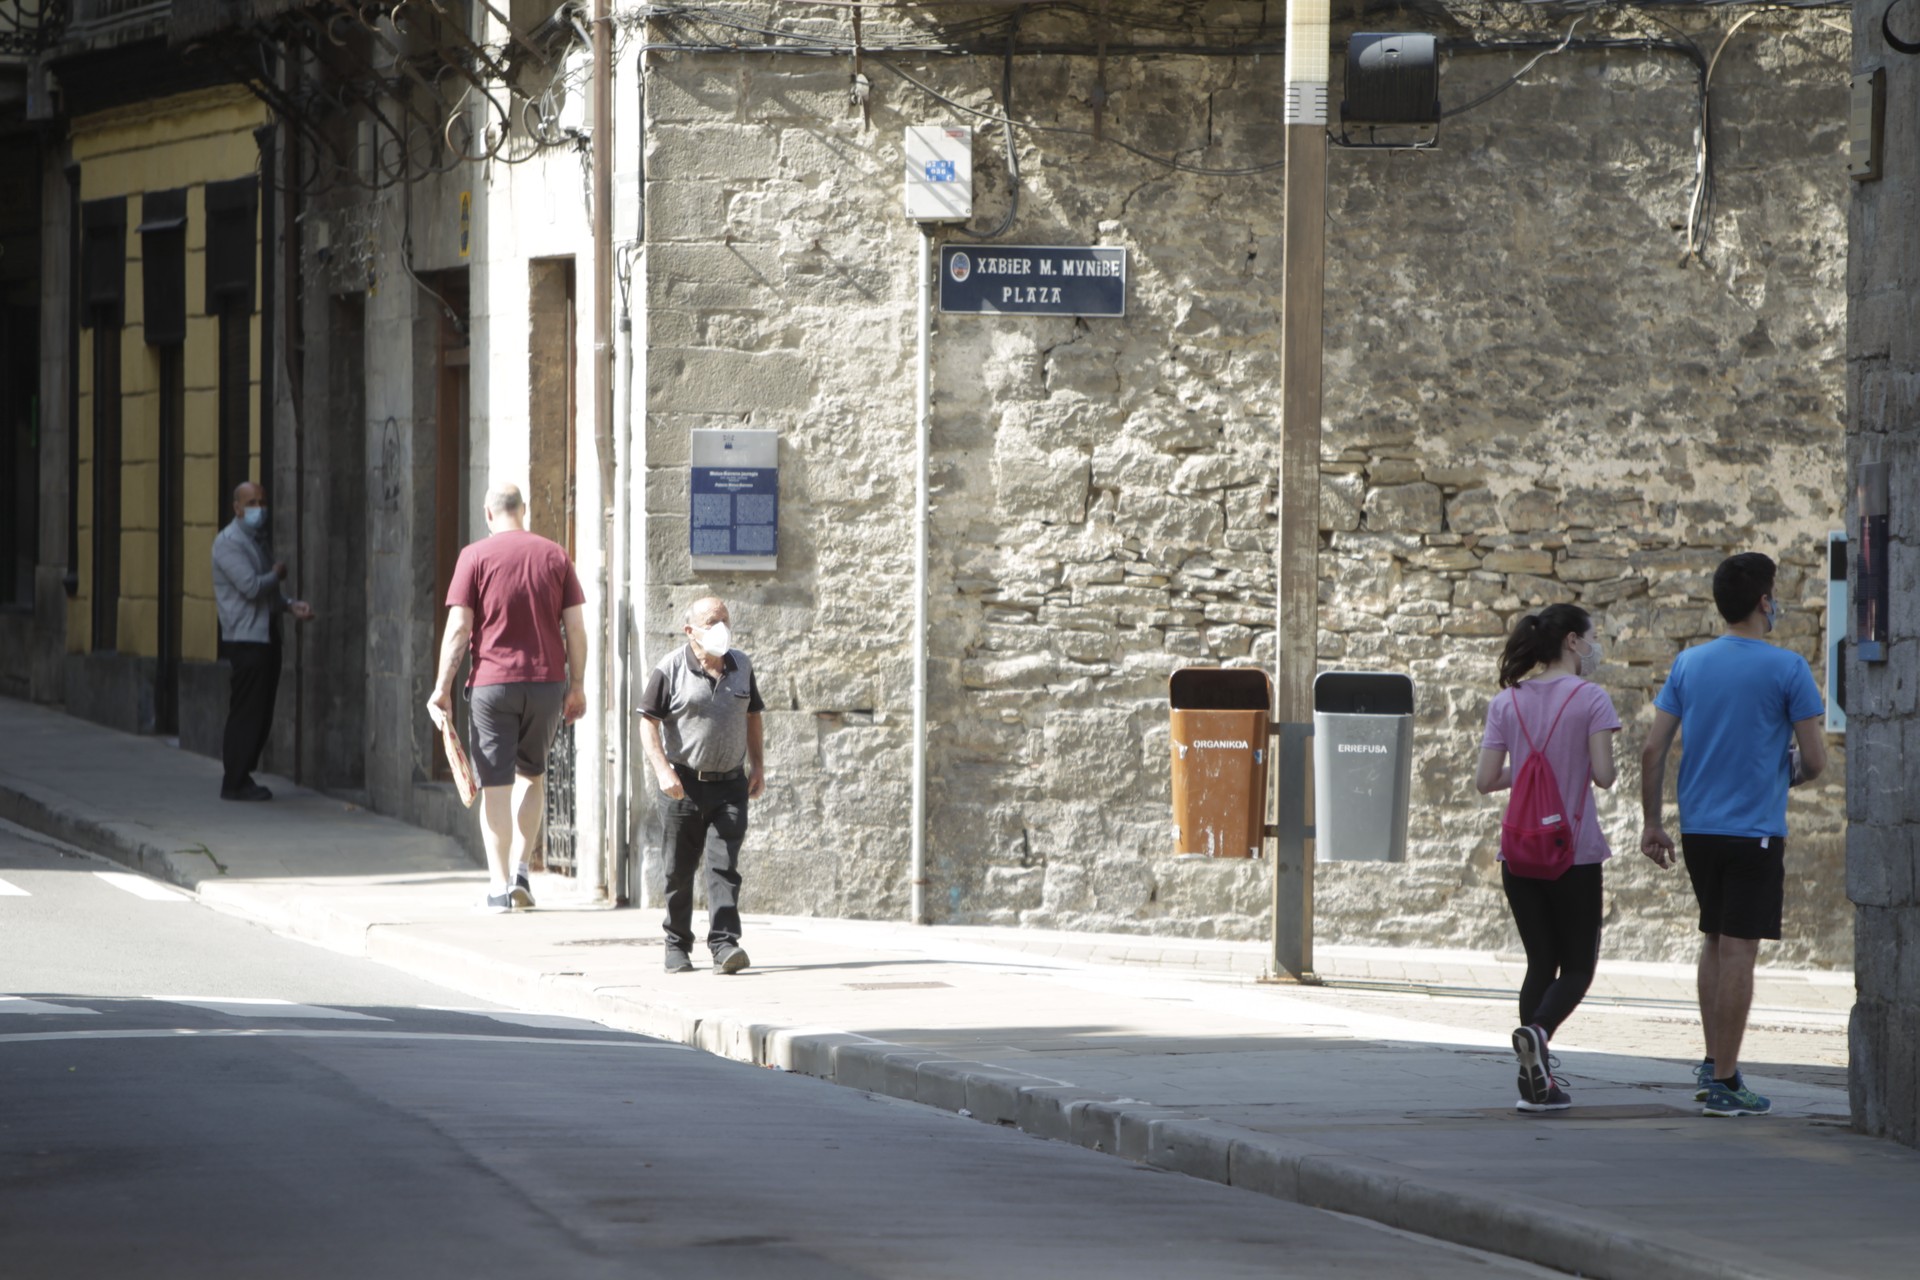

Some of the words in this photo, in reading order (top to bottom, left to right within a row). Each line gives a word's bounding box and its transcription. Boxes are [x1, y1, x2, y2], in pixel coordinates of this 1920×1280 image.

[1040, 259, 1057, 275] M.
[1002, 286, 1061, 303] PLAZA
[1193, 739, 1248, 749] ORGANIKOA
[1338, 743, 1387, 753] ERREFUSA
